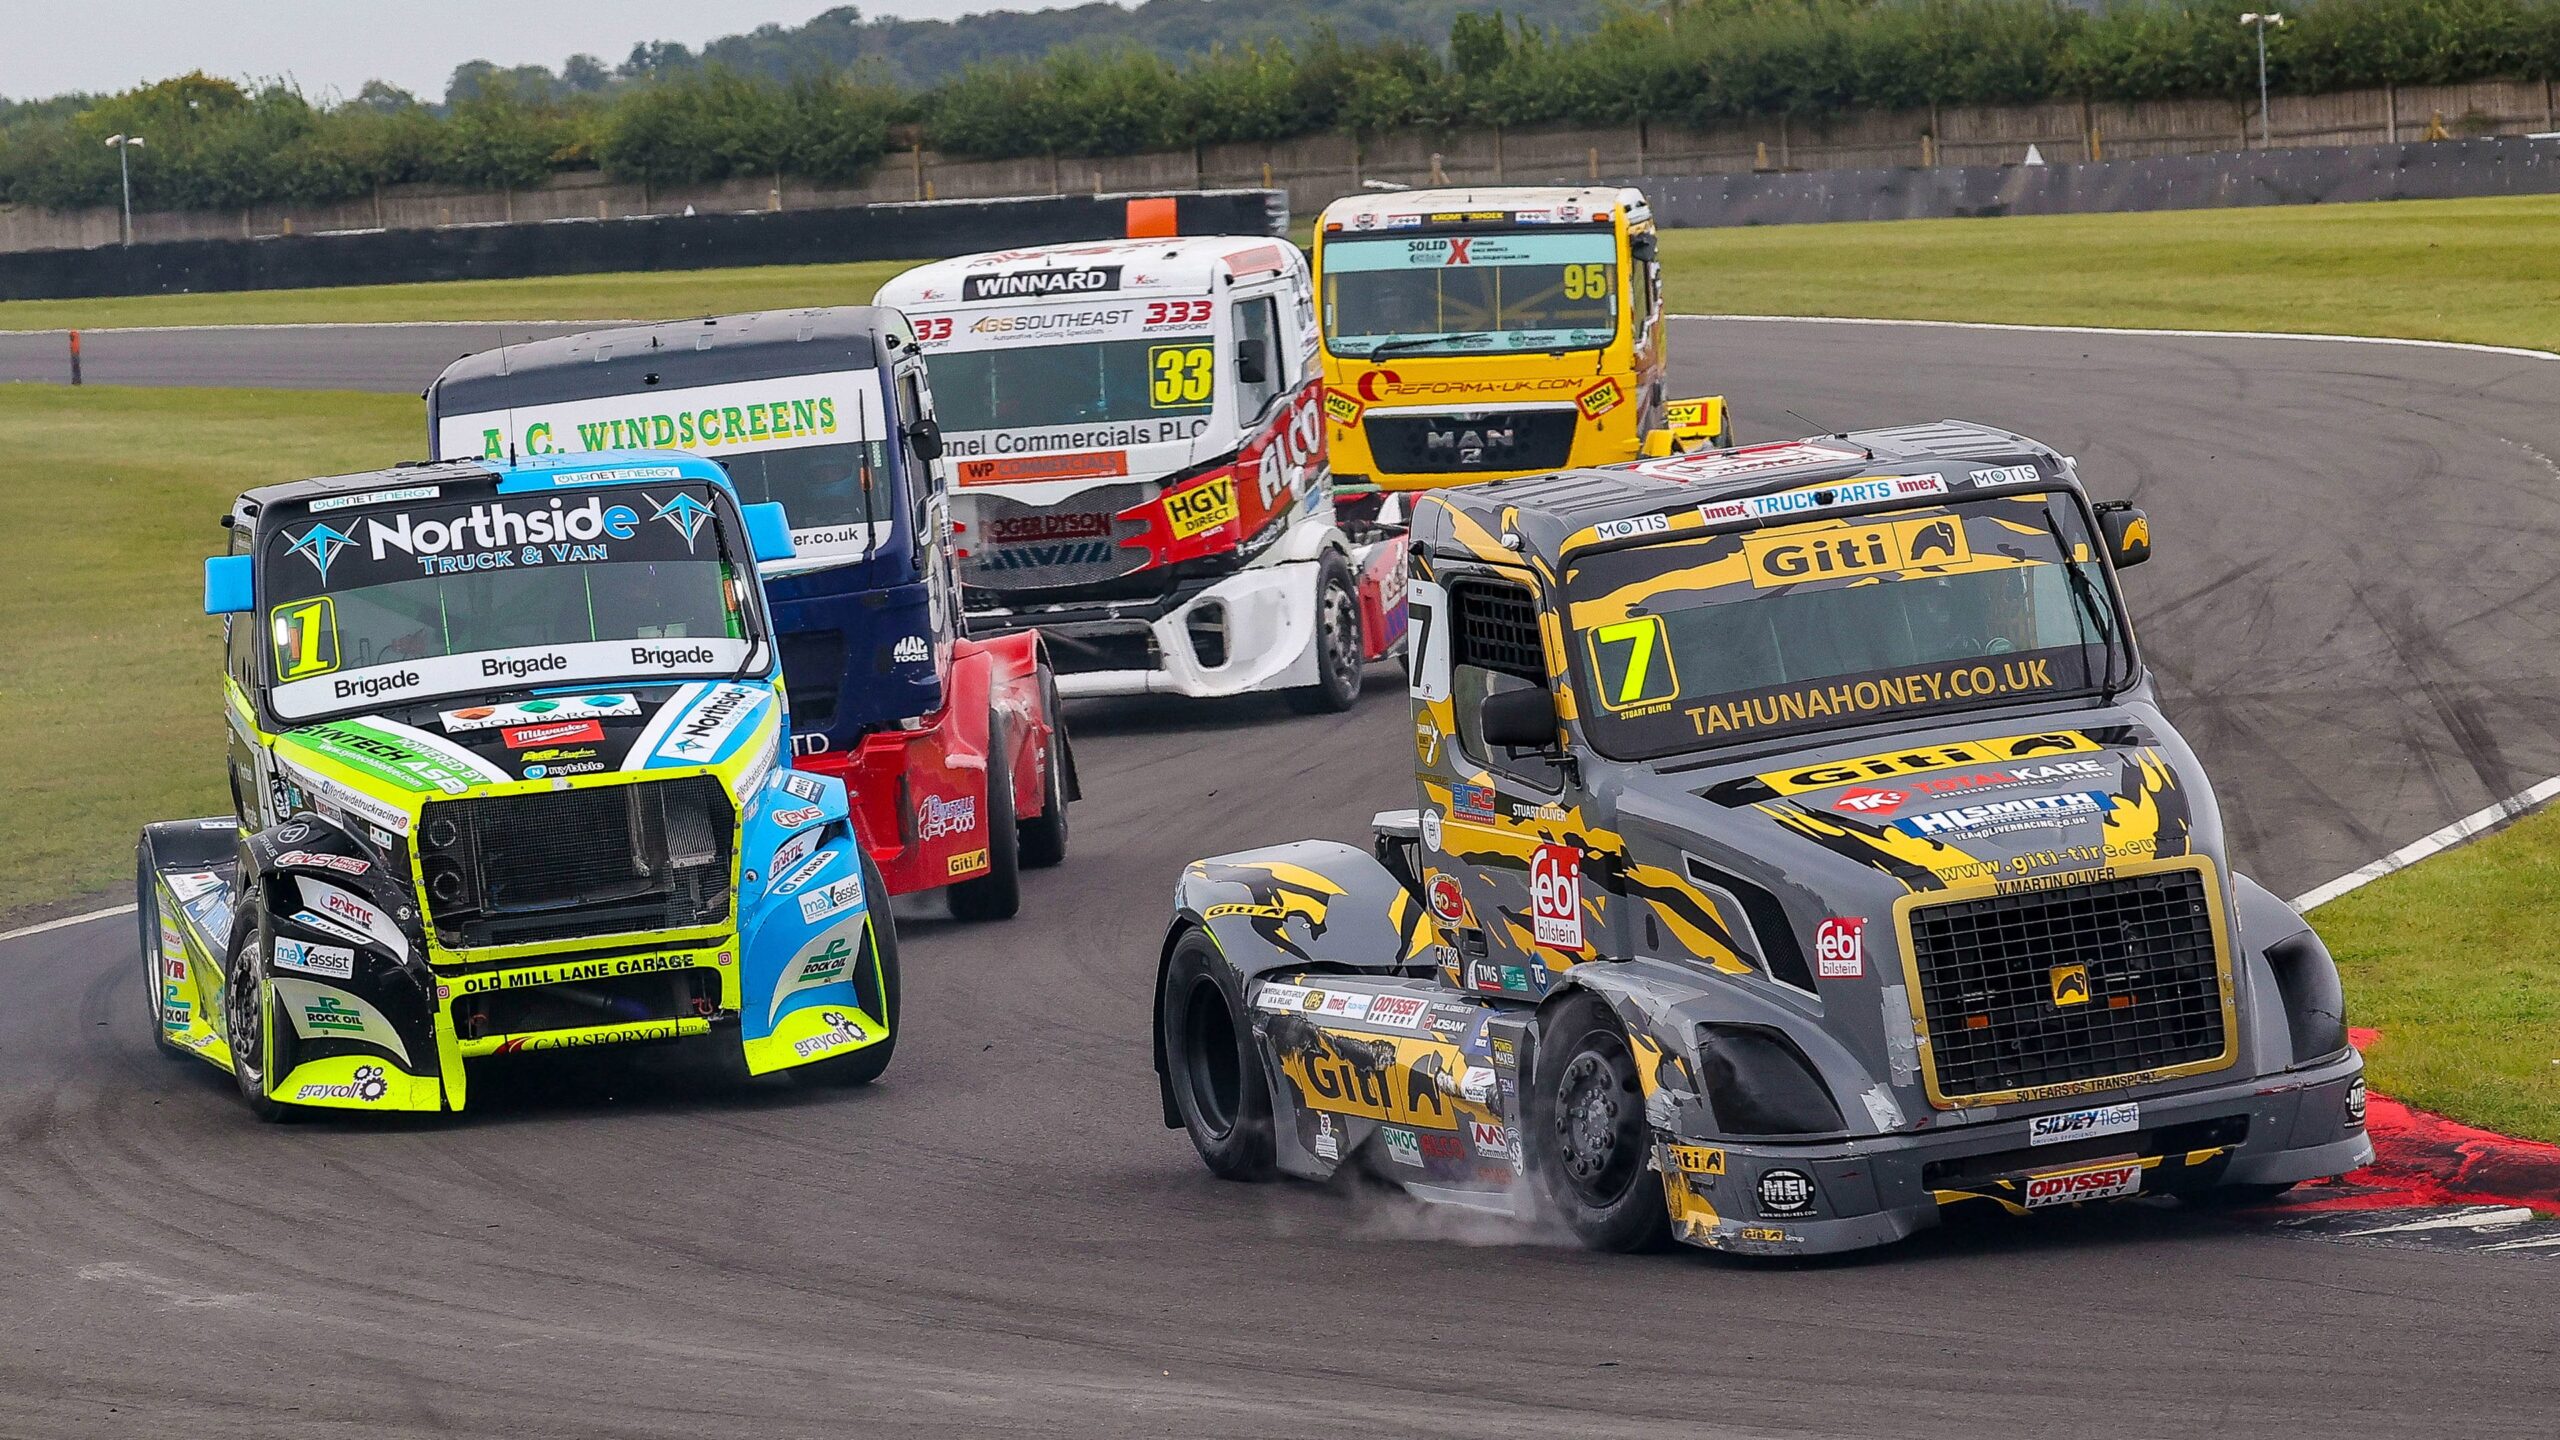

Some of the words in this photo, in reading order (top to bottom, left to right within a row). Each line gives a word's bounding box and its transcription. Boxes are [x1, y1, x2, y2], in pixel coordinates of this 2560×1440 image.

[1408, 240, 1447, 252] SOLID
[975, 271, 1107, 297] WINNARD
[1563, 265, 1607, 300] 95
[1144, 299, 1213, 325] 333
[1142, 323, 1209, 333] MOTORSPORT
[1154, 348, 1214, 403] 33
[1384, 379, 1583, 396] REFORMA-UK.COM
[1326, 395, 1356, 414] HGV
[1583, 385, 1612, 408] HGV
[577, 397, 838, 451] WINDSCREENS
[995, 424, 1150, 453] Commercials
[1159, 419, 1209, 442] PLC
[1427, 429, 1514, 448] MAN
[968, 462, 995, 478] WP
[1973, 465, 2037, 487] MOTIS
[1168, 481, 1228, 523] HGV
[1703, 503, 1747, 520] imex
[1753, 493, 1818, 515] TRUCK
[1831, 482, 1892, 504] PARTS
[1896, 477, 1938, 493] imex
[367, 496, 640, 562] Northside
[1185, 508, 1230, 532] DIRECT
[1598, 515, 1667, 540] MOTIS
[417, 549, 515, 575] TRUCK
[521, 545, 544, 565] &
[548, 543, 609, 563] VAN
[1762, 534, 1887, 577] Giti
[287, 604, 328, 676] 1
[893, 635, 929, 656] MAC
[1408, 603, 1433, 688] 7
[481, 653, 567, 678] Brigade
[631, 645, 714, 668] Brigade
[893, 653, 930, 663] TOOLS
[1598, 617, 1657, 703] 7
[334, 670, 420, 699] Brigade
[1685, 659, 2054, 736] TAHUNAHONEY.CO.UK
[449, 716, 529, 733] ASTON
[537, 707, 639, 721] BARCLAY
[1620, 708, 1646, 720] STUART
[1647, 702, 1672, 715] OLIVER
[293, 724, 416, 762] SYNTECH
[512, 722, 590, 741] Milwaukee
[392, 736, 470, 771] POWERED
[460, 768, 490, 784] BY
[1789, 748, 1977, 786] Giti
[401, 760, 469, 795] ASB
[1909, 759, 2106, 795] TOTALKARE
[1931, 786, 1992, 799] WORKSHOP
[1996, 778, 2060, 791] EQUIPMENT
[2064, 771, 2114, 782] EXPERTS
[1512, 804, 1539, 819] STUART
[1539, 806, 1567, 822] OLIVER
[773, 841, 804, 874] PARTIC
[794, 851, 832, 883] nybble
[950, 856, 974, 872] Giti
[1937, 838, 2158, 881] www.giti-tire.eu
[1529, 848, 1580, 919] febi
[1994, 873, 2064, 896] W.MARTIN
[2067, 867, 2116, 885] OLIVER
[329, 895, 374, 925] PARTIC
[1208, 905, 1256, 917] Giti
[1537, 917, 1578, 945] bilstein
[1815, 919, 1864, 961] febi
[464, 976, 501, 993] OLD
[509, 970, 554, 988] MILL
[560, 964, 610, 982] LANE
[616, 953, 695, 975] GARAGE
[803, 960, 831, 975] ROCK
[831, 957, 847, 970] OIL
[1477, 964, 1498, 983] TMS
[1821, 960, 1859, 977] bilstein
[1326, 995, 1348, 1010] imex
[1373, 996, 1424, 1017] ODYSSEY
[307, 1013, 340, 1023] ROCK
[343, 1015, 364, 1025] OIL
[1369, 1012, 1414, 1026] BATTERY
[1434, 1019, 1465, 1032] JOSAM
[794, 1027, 851, 1058] graycoll
[1493, 1039, 1513, 1051] POWER
[1495, 1050, 1515, 1065] MAXED
[296, 1080, 360, 1100] graycoll
[2016, 1090, 2029, 1102] 50
[2032, 1086, 2069, 1100] YEARS
[2091, 1071, 2158, 1091] TRANSPORT
[2033, 1110, 2099, 1137] SILVEY
[2099, 1106, 2138, 1127] fleet
[1383, 1127, 1419, 1151] BWOC
[1670, 1150, 1699, 1169] iti
[1763, 1179, 1807, 1196] MEI
[2028, 1167, 2135, 1198] ODYSSEY
[2027, 1186, 2127, 1206] BATTERY
[1744, 1229, 1766, 1239] Giti
